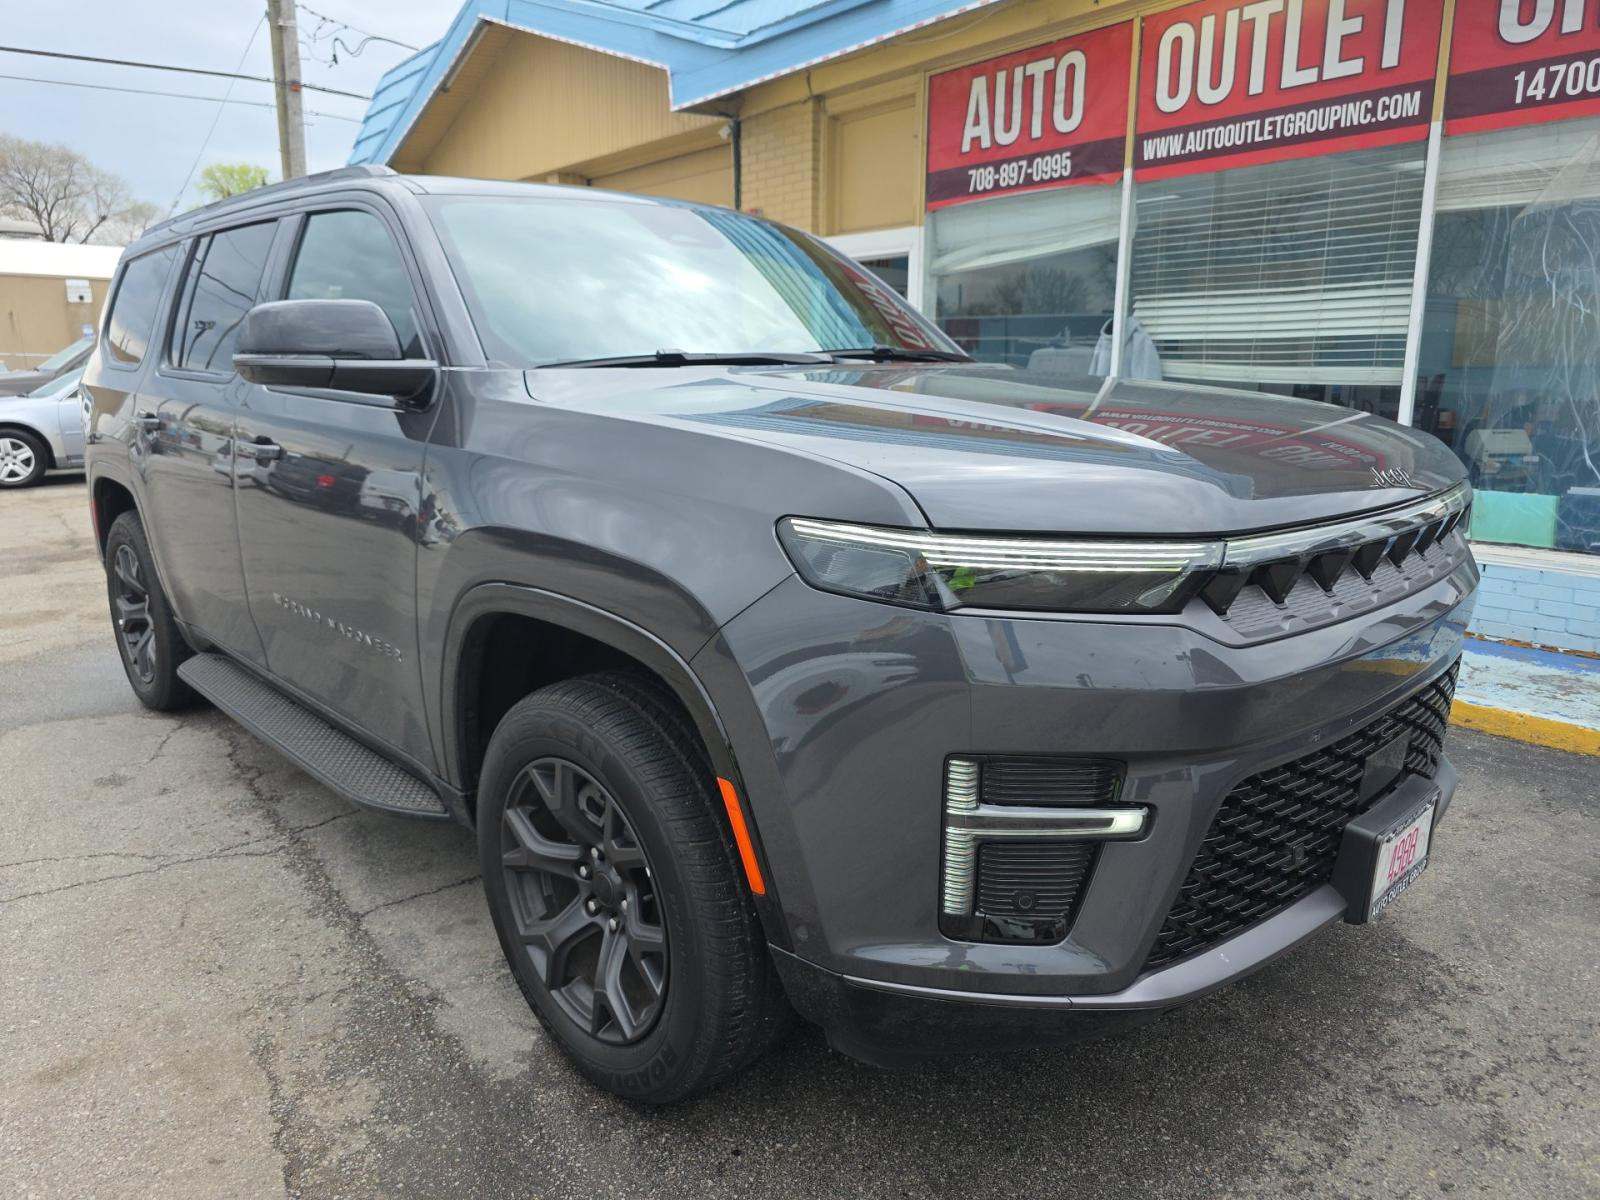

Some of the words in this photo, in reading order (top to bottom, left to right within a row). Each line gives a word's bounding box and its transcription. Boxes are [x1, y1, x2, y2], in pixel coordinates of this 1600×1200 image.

[961, 50, 1087, 153] AUTO
[1143, 91, 1421, 161] WWW.AUTOOUTLETGROUPINC.COM
[968, 152, 1072, 193] 708-897-0995
[1369, 466, 1415, 488] Jeep
